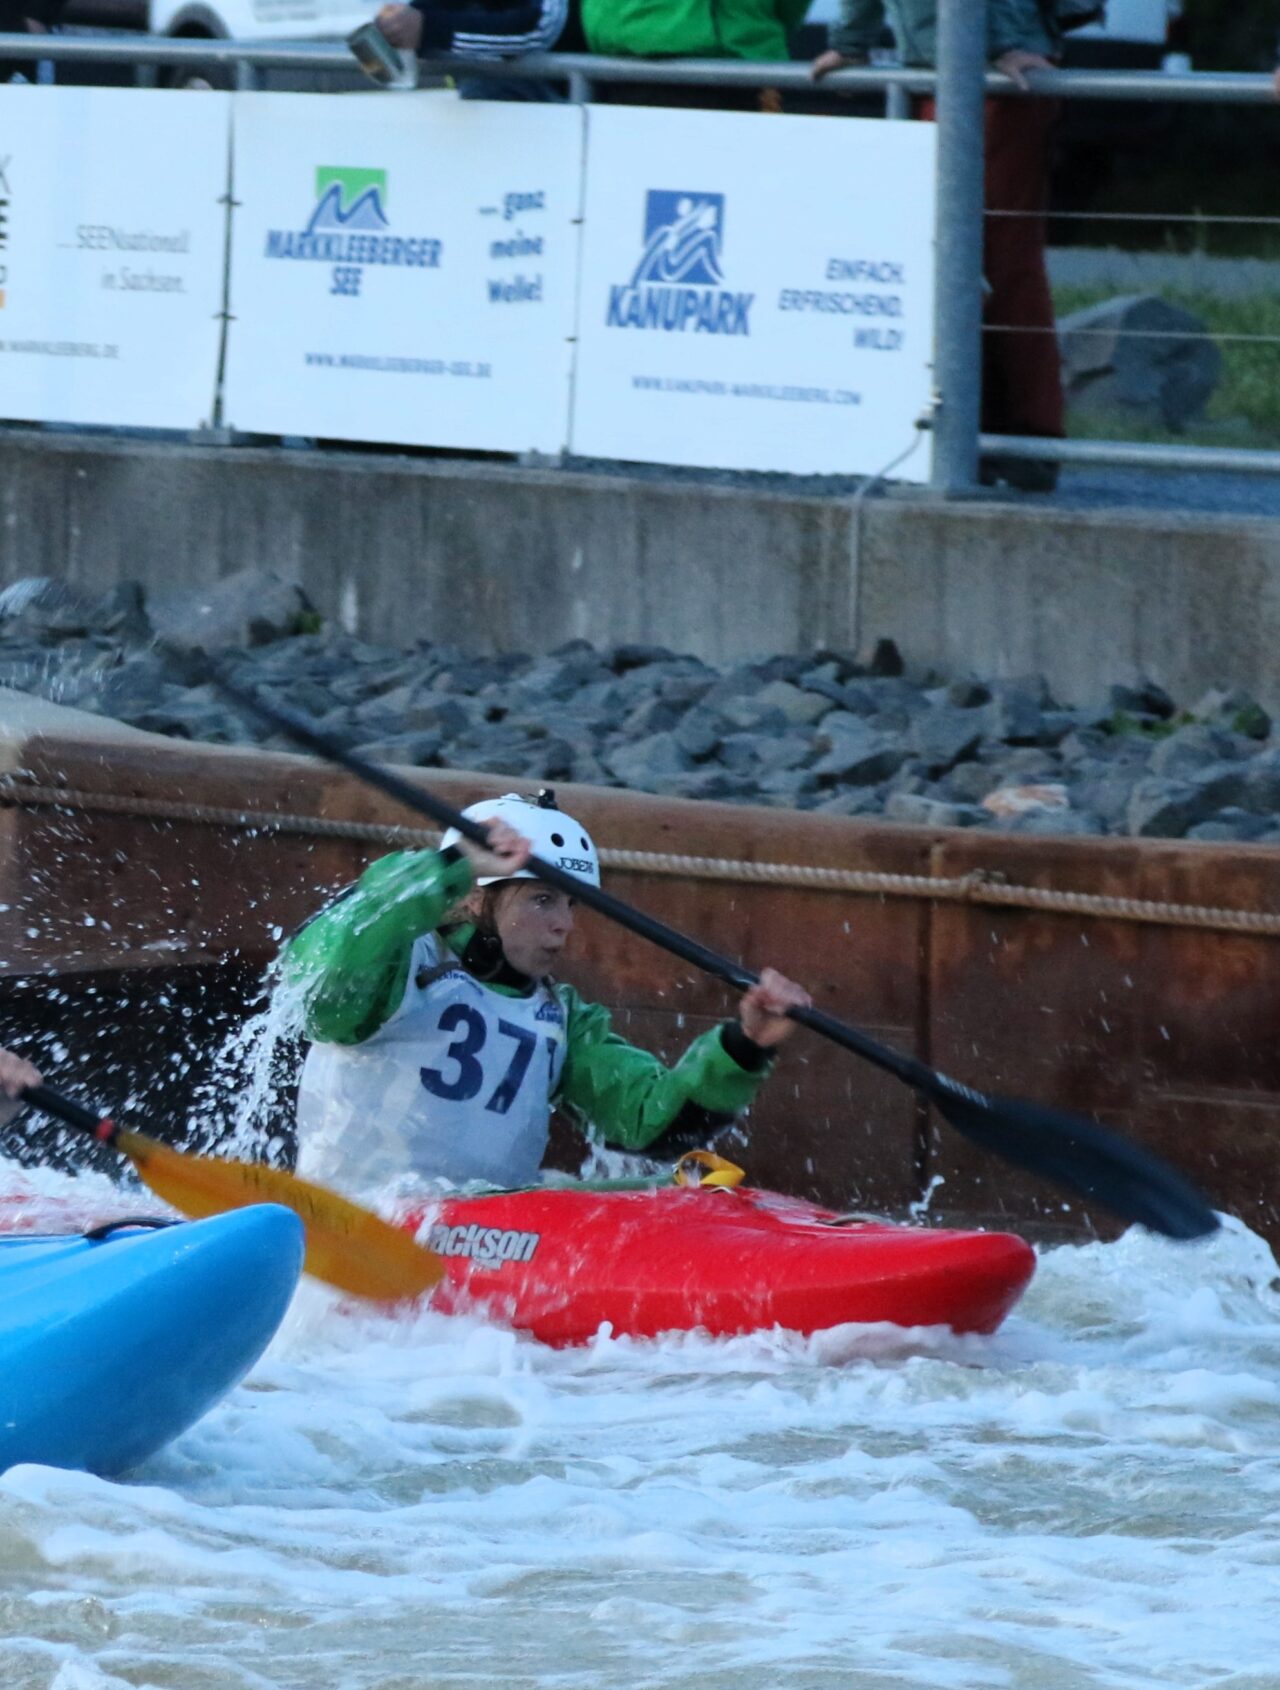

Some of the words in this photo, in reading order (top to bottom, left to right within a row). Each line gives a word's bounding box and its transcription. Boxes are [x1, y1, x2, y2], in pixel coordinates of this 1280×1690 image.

[329, 266, 365, 298] SEE
[605, 284, 755, 337] KANUPARK
[420, 1003, 558, 1114] 37
[423, 1223, 540, 1262] ackson
